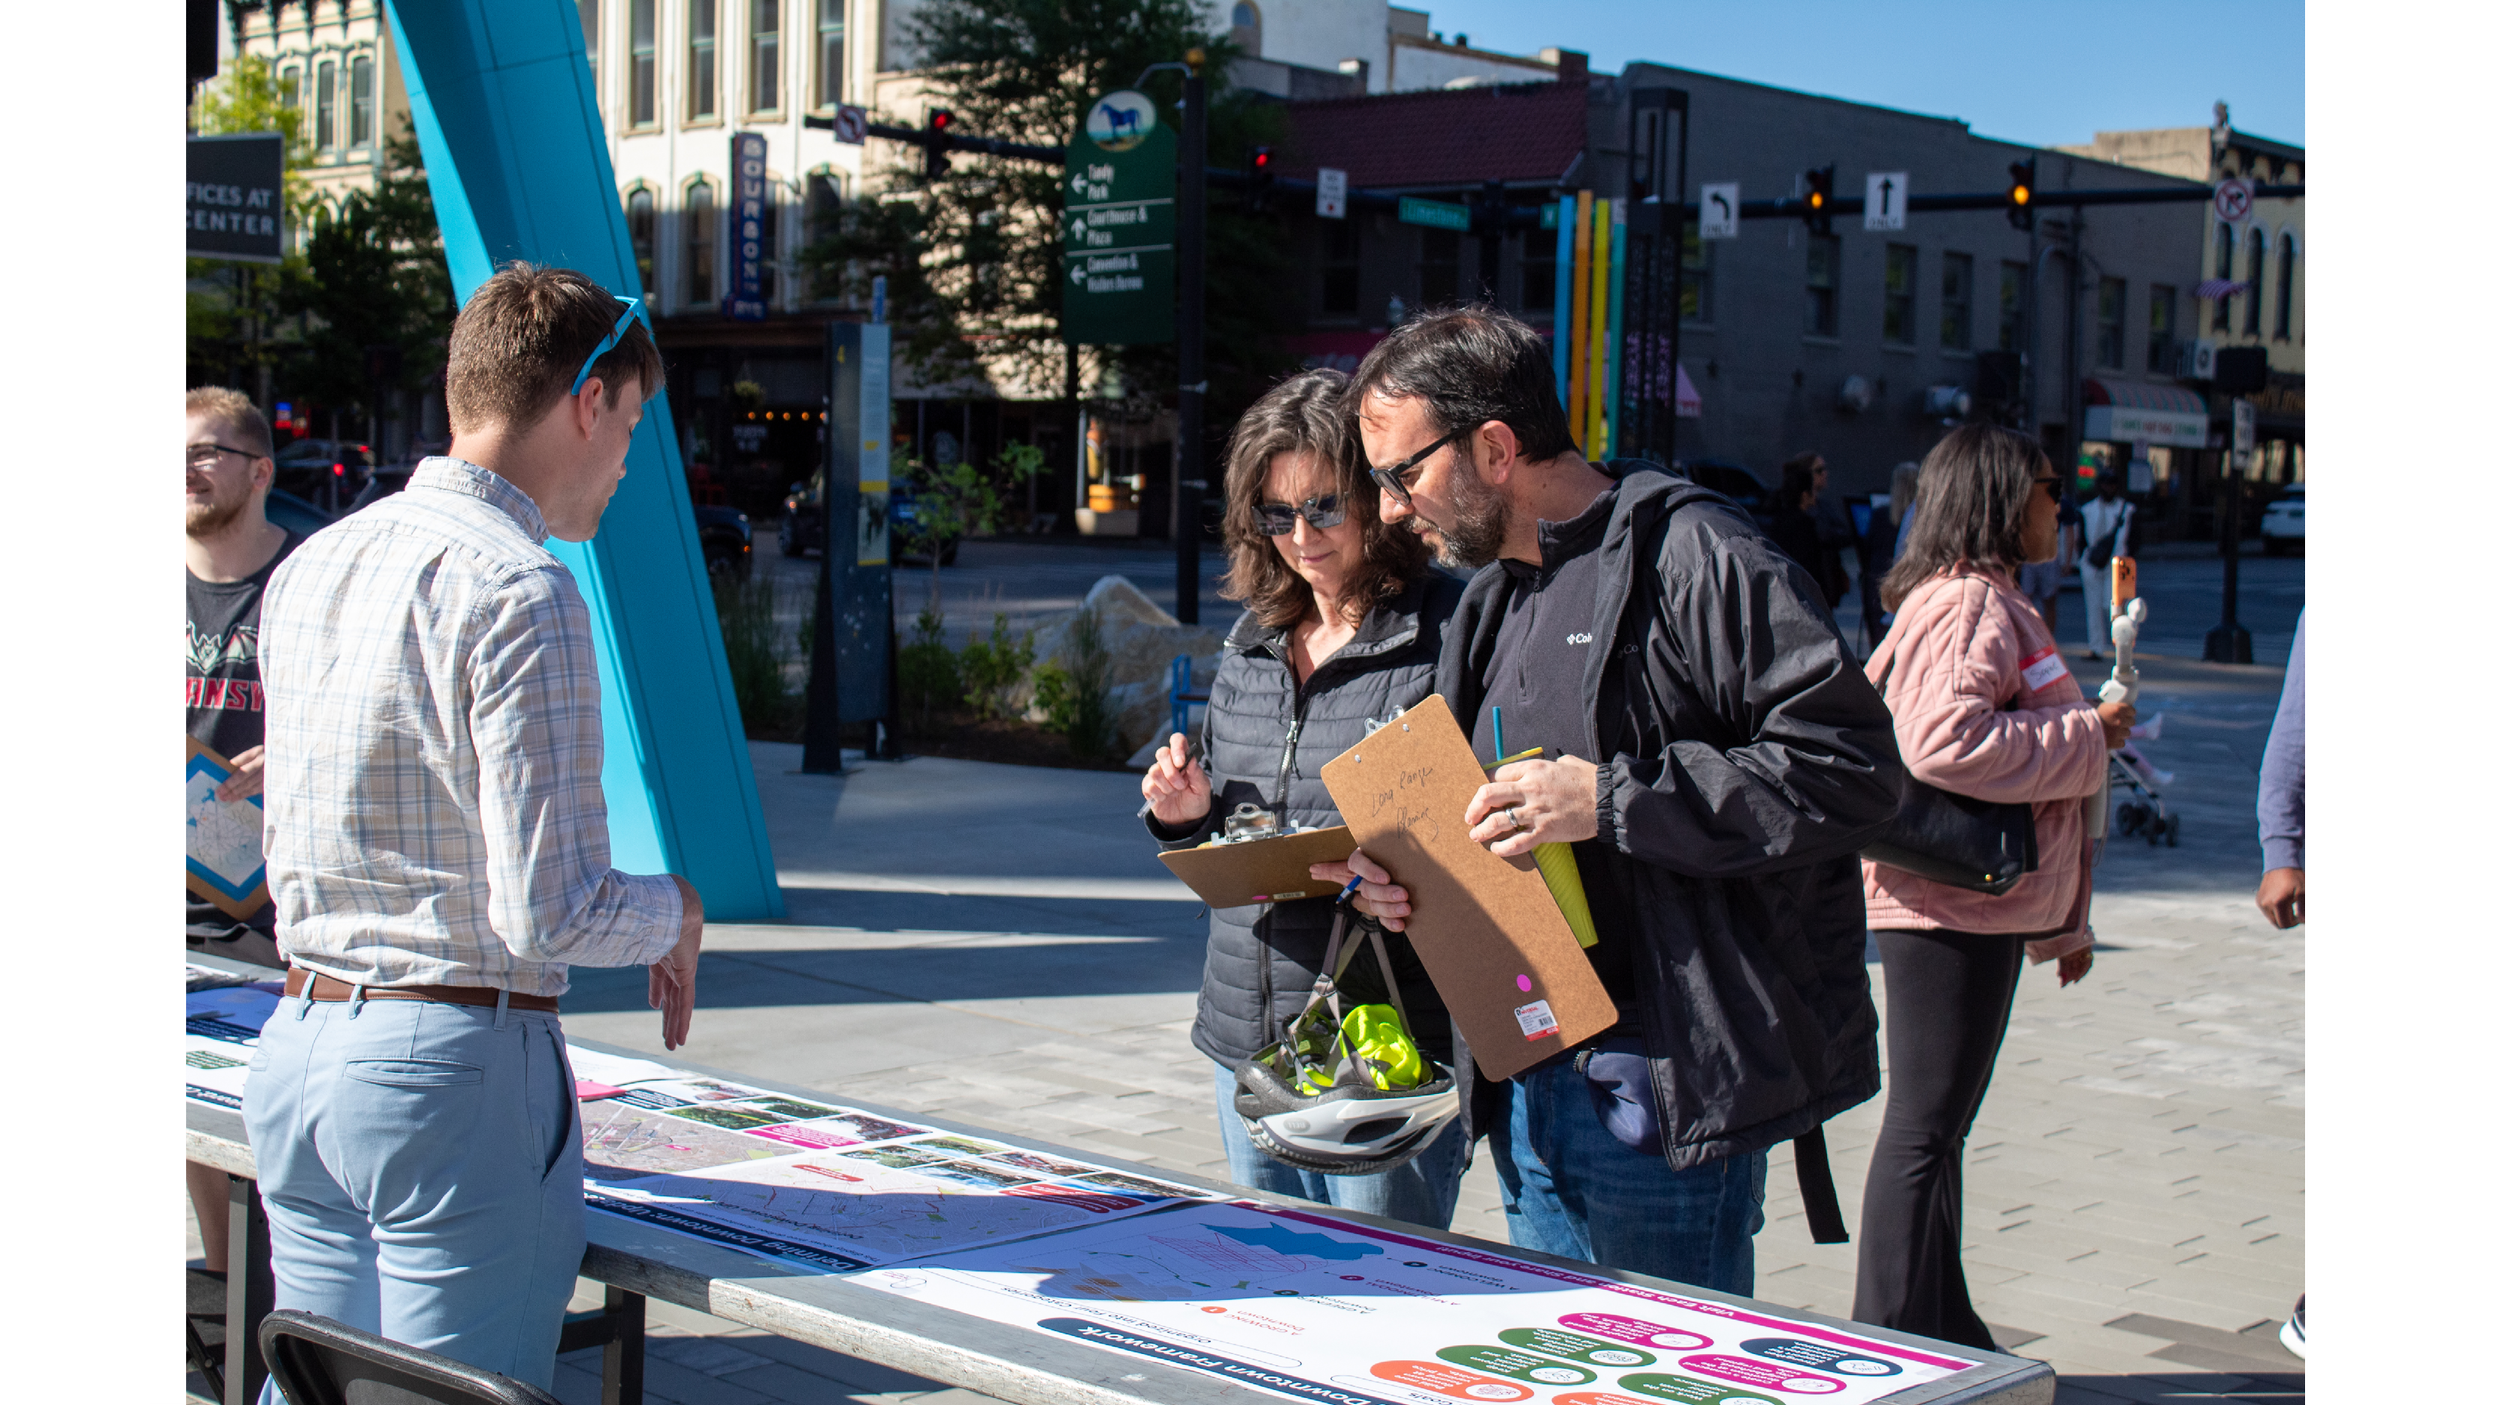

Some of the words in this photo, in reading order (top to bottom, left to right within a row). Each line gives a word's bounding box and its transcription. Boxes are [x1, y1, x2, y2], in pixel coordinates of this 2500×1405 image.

[246, 187, 274, 209] AT
[1087, 183, 1109, 200] Park
[743, 139, 763, 280] BOURBON
[1087, 208, 1137, 227] Courthouse
[1137, 204, 1148, 223] &
[1703, 223, 1730, 234] ONLY
[1869, 217, 1898, 227] ONLY
[1087, 230, 1113, 246] Plaza
[1087, 255, 1128, 273] Convention
[762, 1241, 856, 1269] Defining
[1524, 1264, 1564, 1279] Share
[1566, 1274, 1596, 1287] and
[1598, 1280, 1652, 1300] Station
[1657, 1294, 1698, 1309] Each
[1699, 1303, 1735, 1318] Visit
[1223, 1313, 1288, 1334] GROWING
[1236, 1310, 1306, 1332] Downtown
[1136, 1322, 1212, 1344] Organized
[1077, 1326, 1223, 1367] Framework
[1224, 1364, 1371, 1405] Downtown
